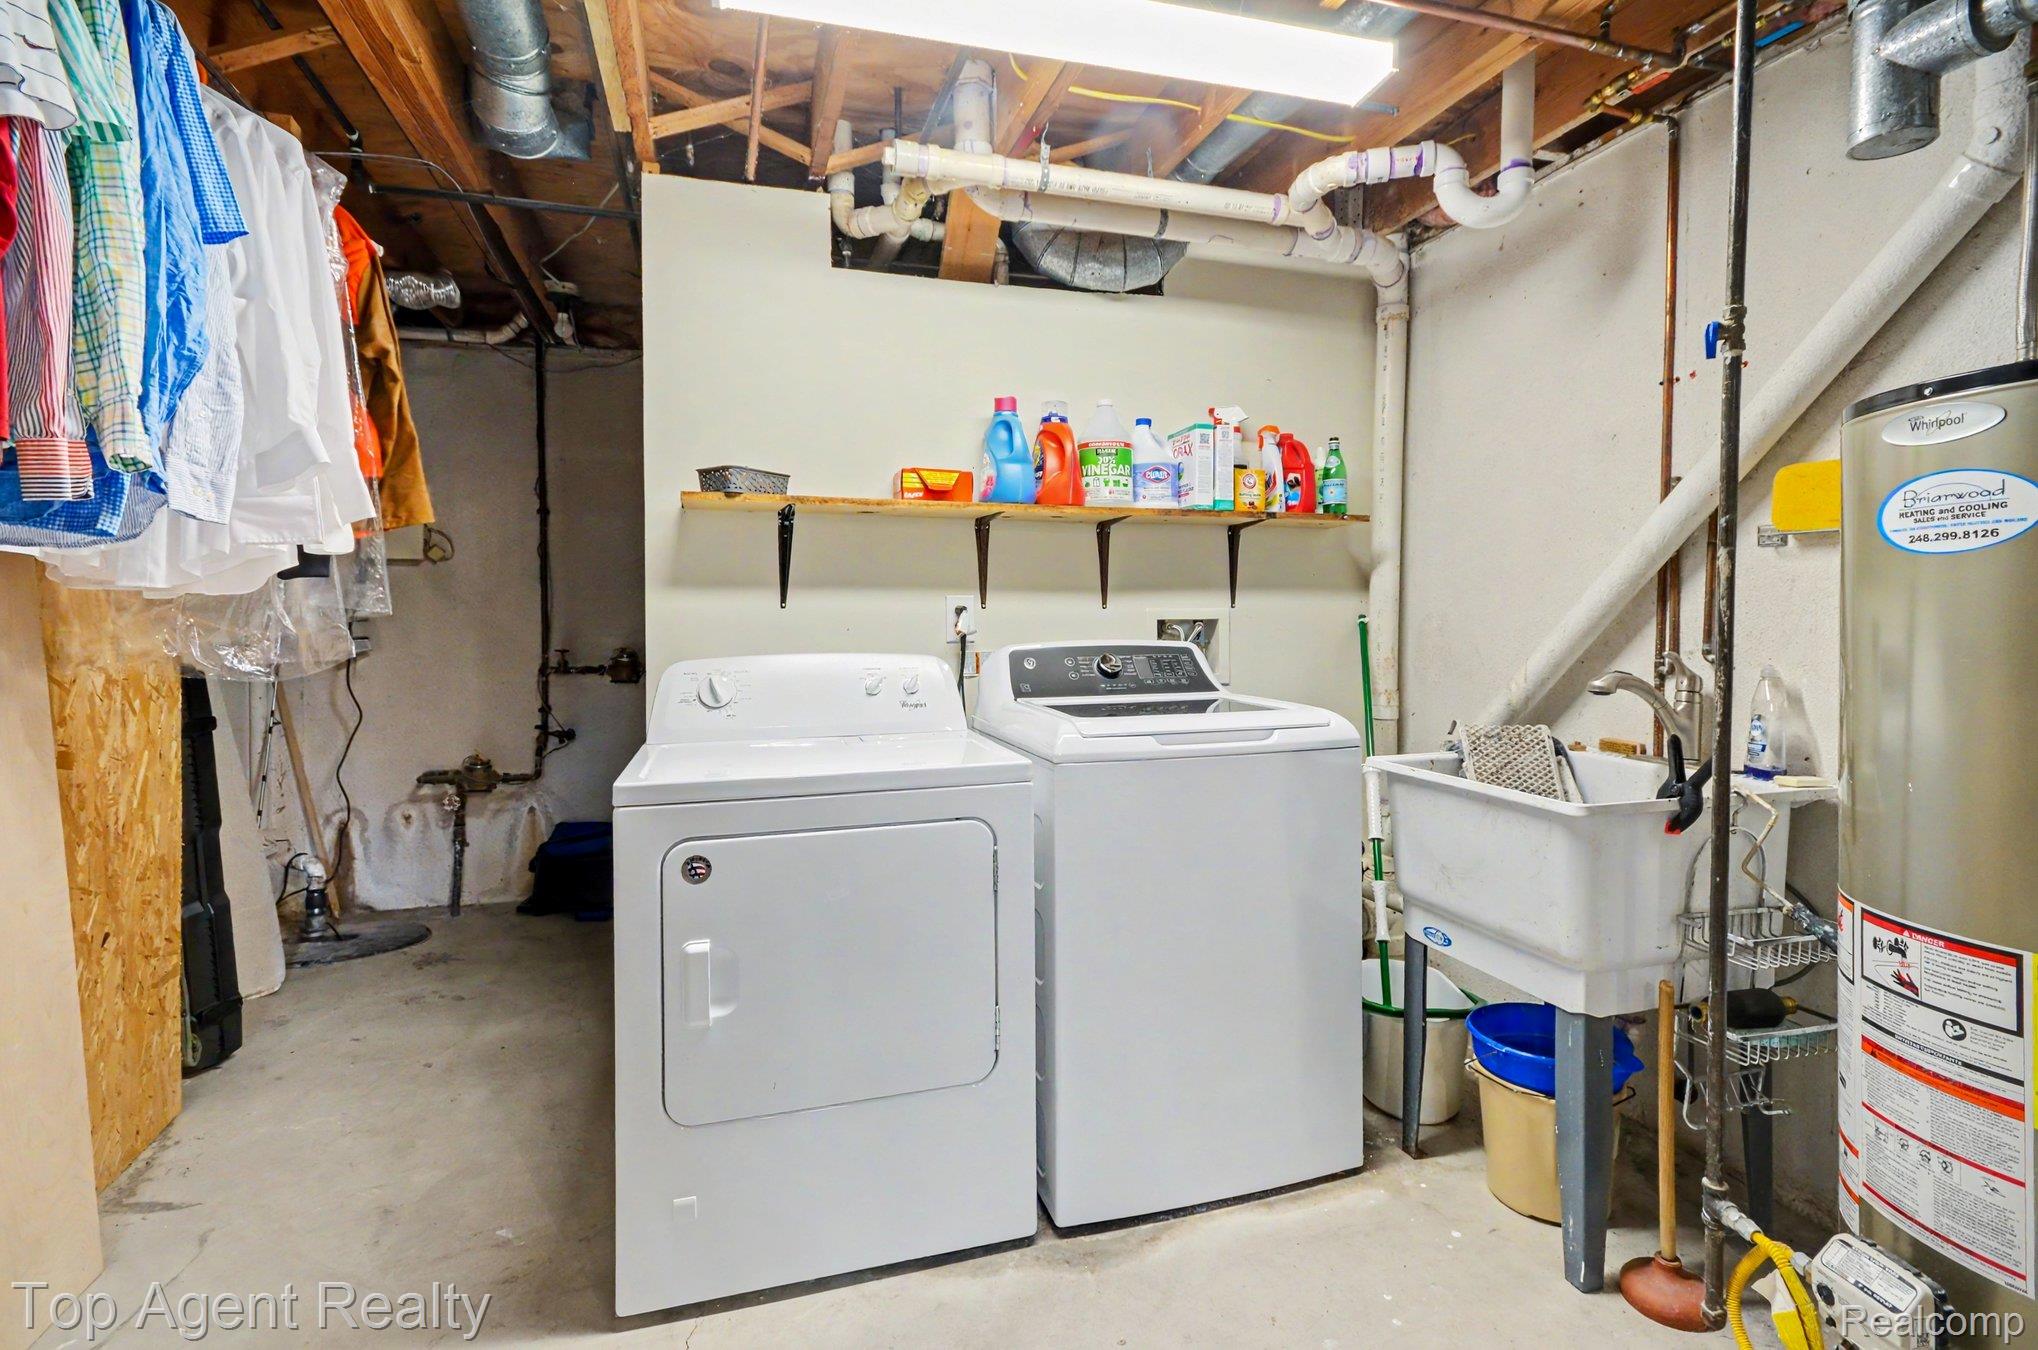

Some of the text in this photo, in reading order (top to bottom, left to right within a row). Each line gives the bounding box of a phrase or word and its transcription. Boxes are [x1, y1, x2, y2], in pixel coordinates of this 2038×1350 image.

[1909, 412, 1966, 432] Whirlpool
[1082, 463, 1131, 477] VINEGAR
[1903, 478, 2006, 509] Briarwood
[1899, 501, 2009, 519] HEATING and COOLING
[1913, 516, 1936, 524] SALES
[1950, 511, 1987, 520] SERVICE
[1908, 528, 2000, 544] 248.299.8126
[1911, 933, 1946, 948] DANGER
